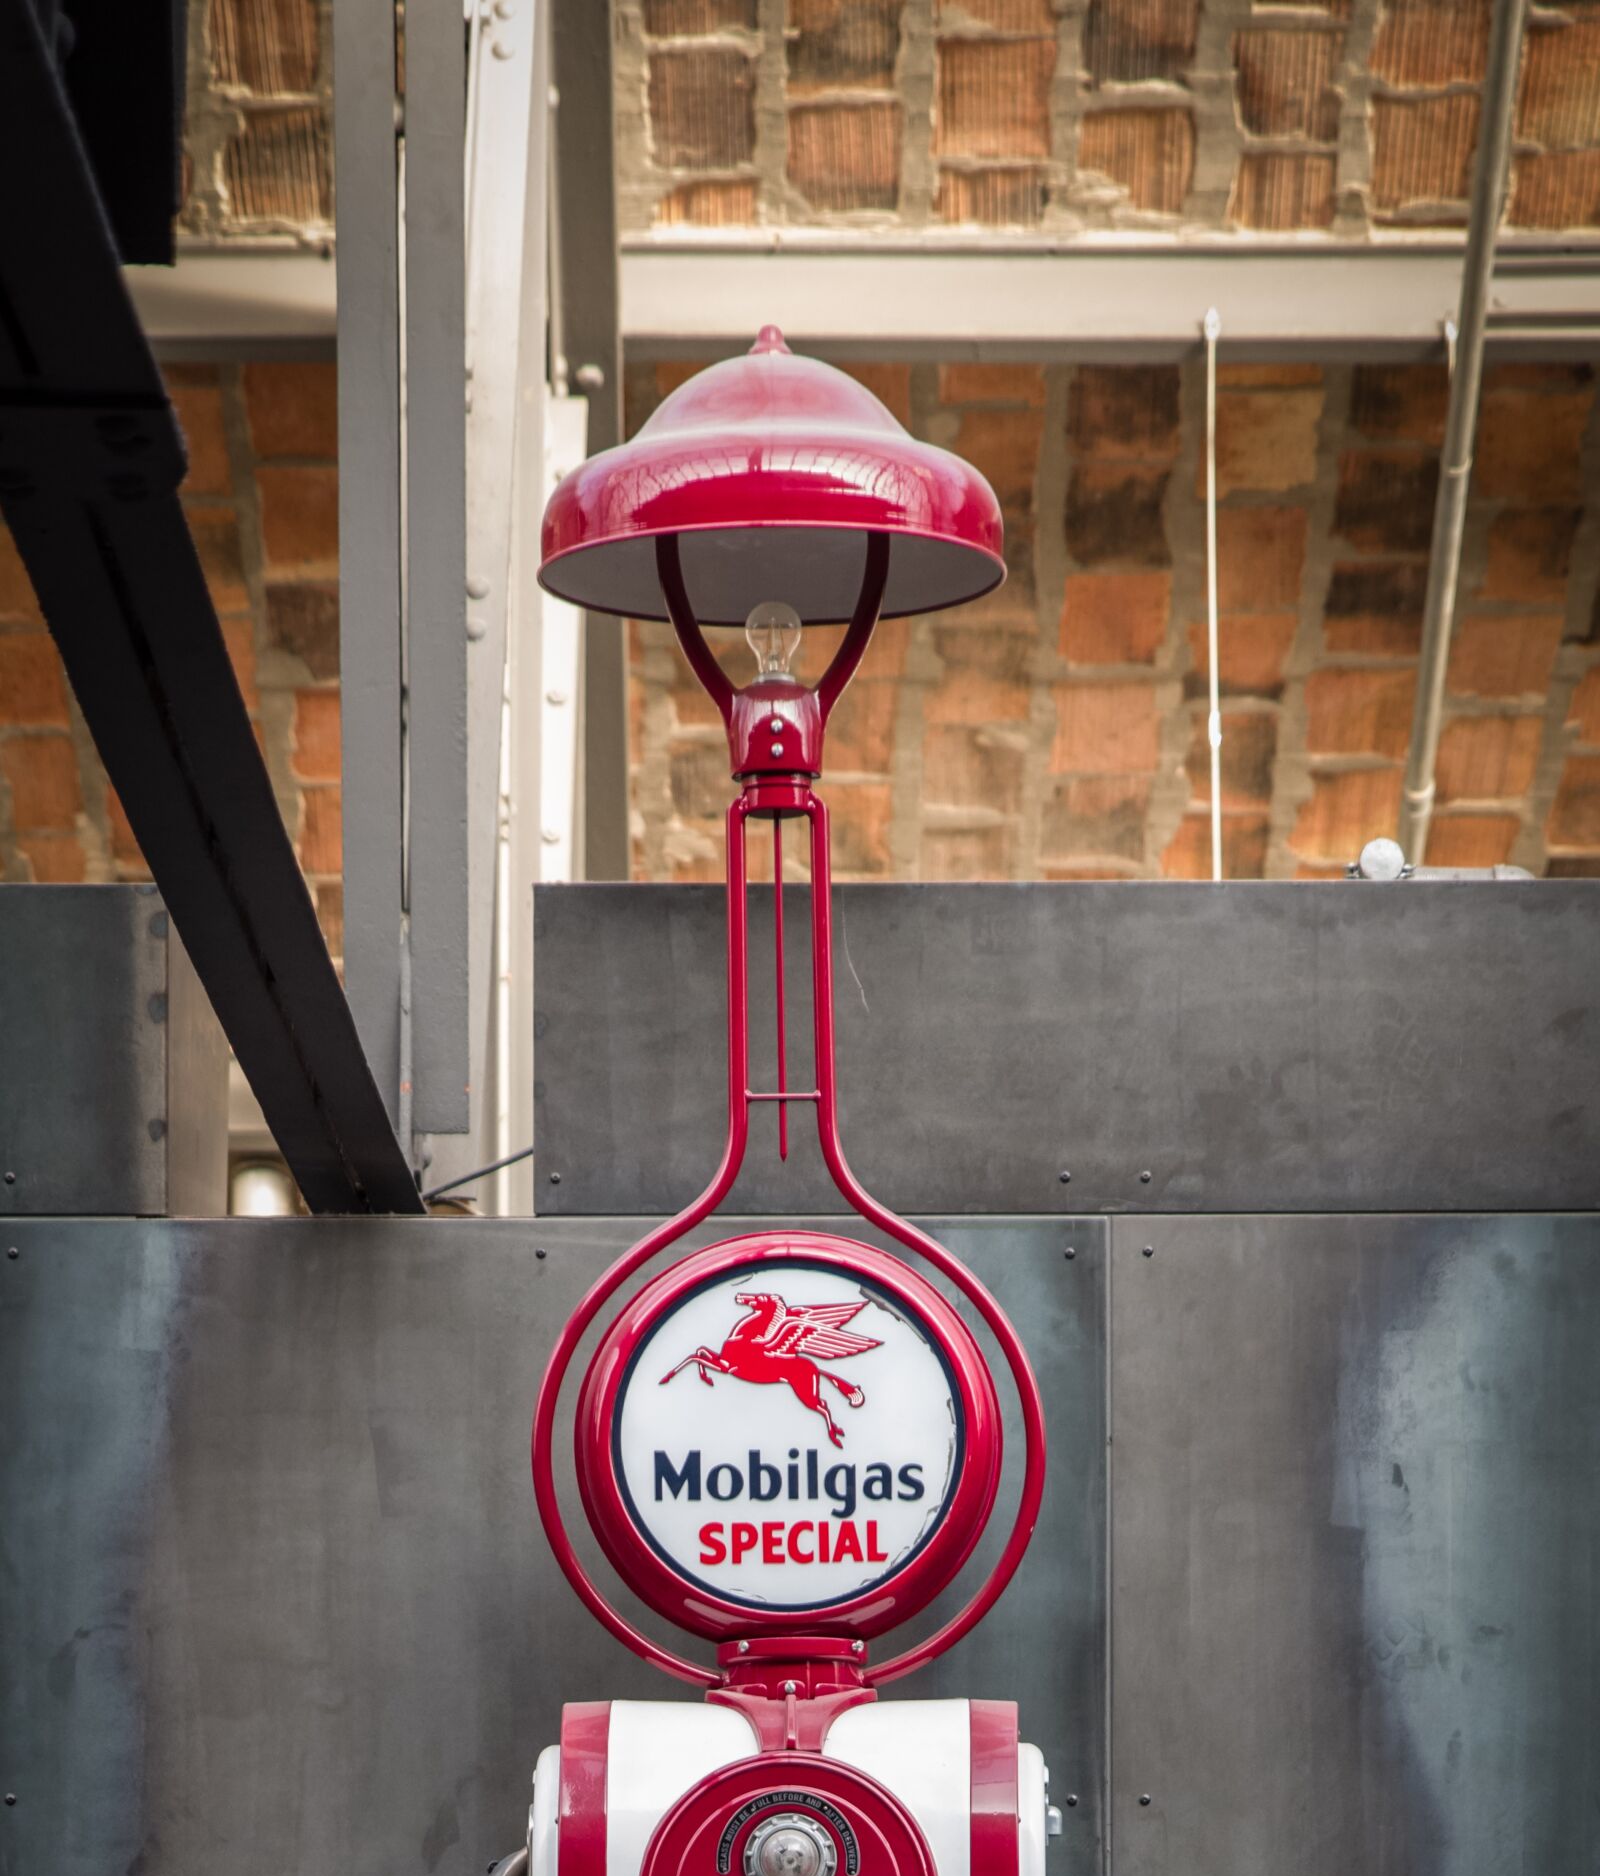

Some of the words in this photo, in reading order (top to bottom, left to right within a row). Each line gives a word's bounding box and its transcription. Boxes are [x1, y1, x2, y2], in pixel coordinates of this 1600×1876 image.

[653, 1447, 926, 1519] Mobilgas
[698, 1519, 889, 1565] SPECIAL
[719, 1842, 730, 1869] GLASS
[725, 1820, 741, 1842] MUST
[738, 1809, 750, 1821] BE
[750, 1796, 771, 1810] FULL
[772, 1792, 804, 1803] BEFORE
[805, 1796, 822, 1809] AND
[825, 1808, 846, 1832] AFTER
[842, 1831, 857, 1870] DELIVERY
